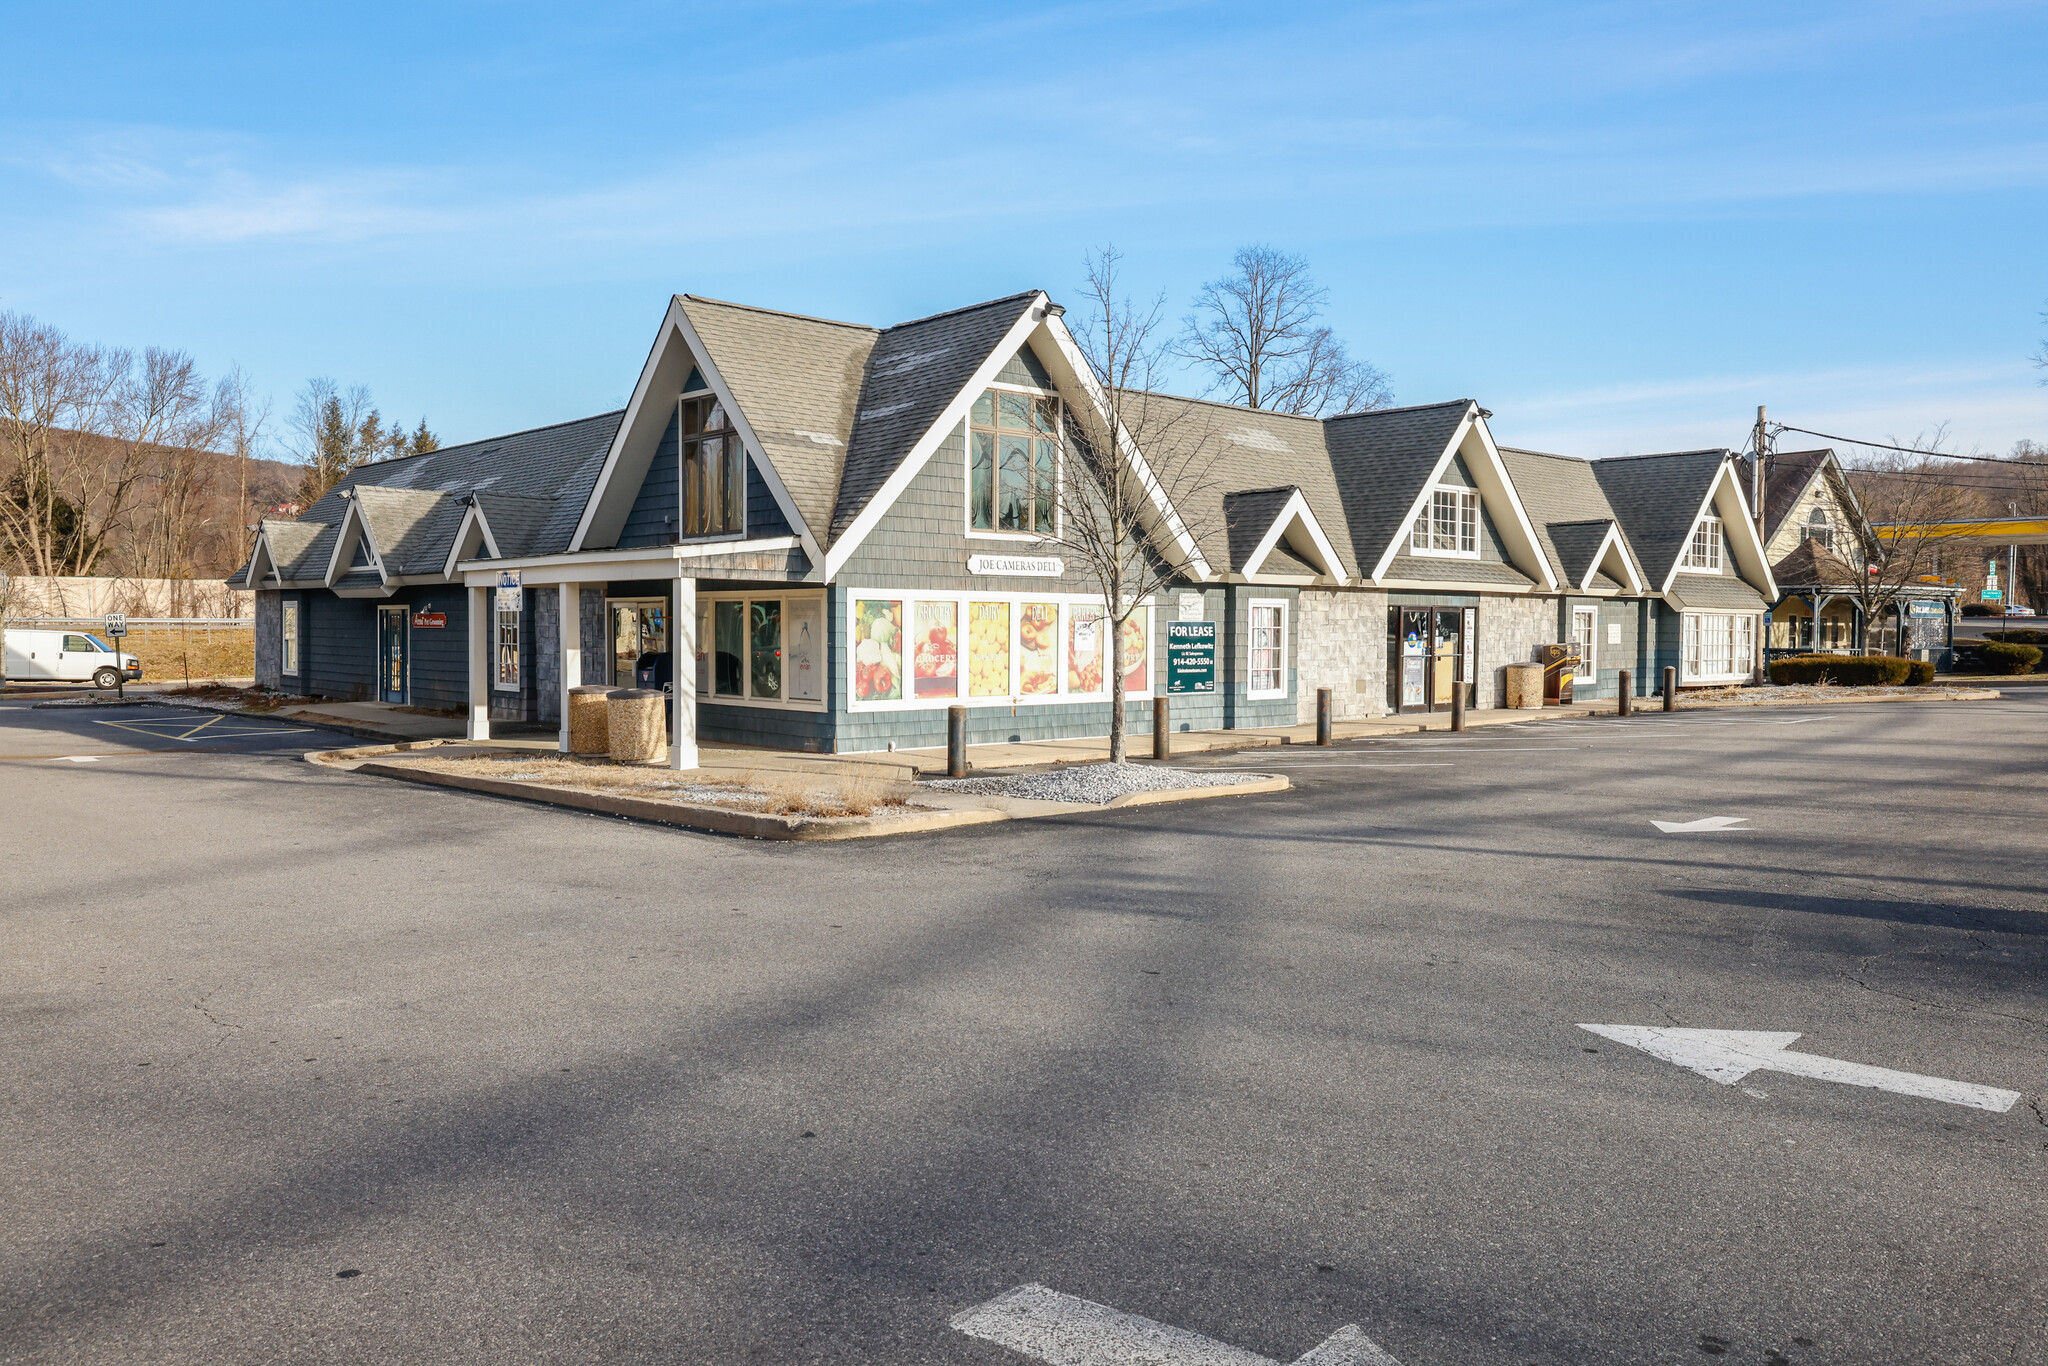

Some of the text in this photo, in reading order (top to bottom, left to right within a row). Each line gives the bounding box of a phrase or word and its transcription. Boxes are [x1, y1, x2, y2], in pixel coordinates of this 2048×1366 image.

[978, 559, 1056, 572] JOE CAMERAS DELI
[498, 574, 520, 586] NOTICE
[917, 604, 955, 620] GROCERY
[978, 604, 1001, 620] DAIRY
[1031, 605, 1048, 621] DELI
[1169, 626, 1214, 637] FOR LEASE
[916, 654, 956, 663] GROCERY
[1173, 657, 1210, 666] 914-420-5550
